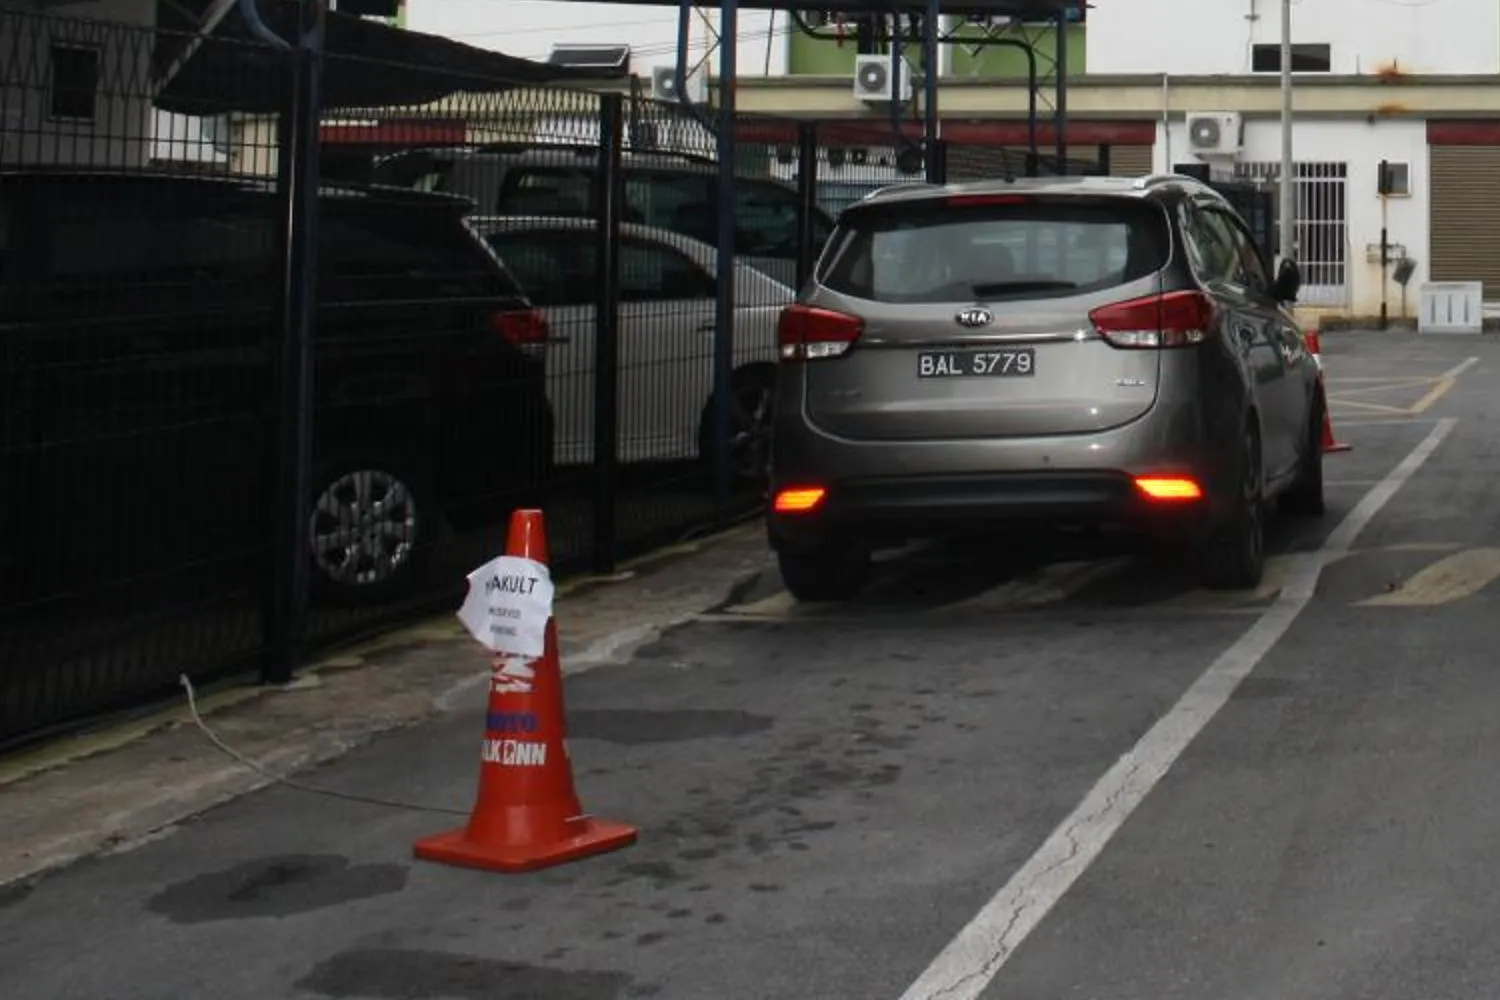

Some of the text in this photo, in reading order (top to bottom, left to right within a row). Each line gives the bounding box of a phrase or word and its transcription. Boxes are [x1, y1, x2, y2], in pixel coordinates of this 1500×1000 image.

[960, 311, 988, 324] KIA
[920, 352, 1032, 376] BAL 5779
